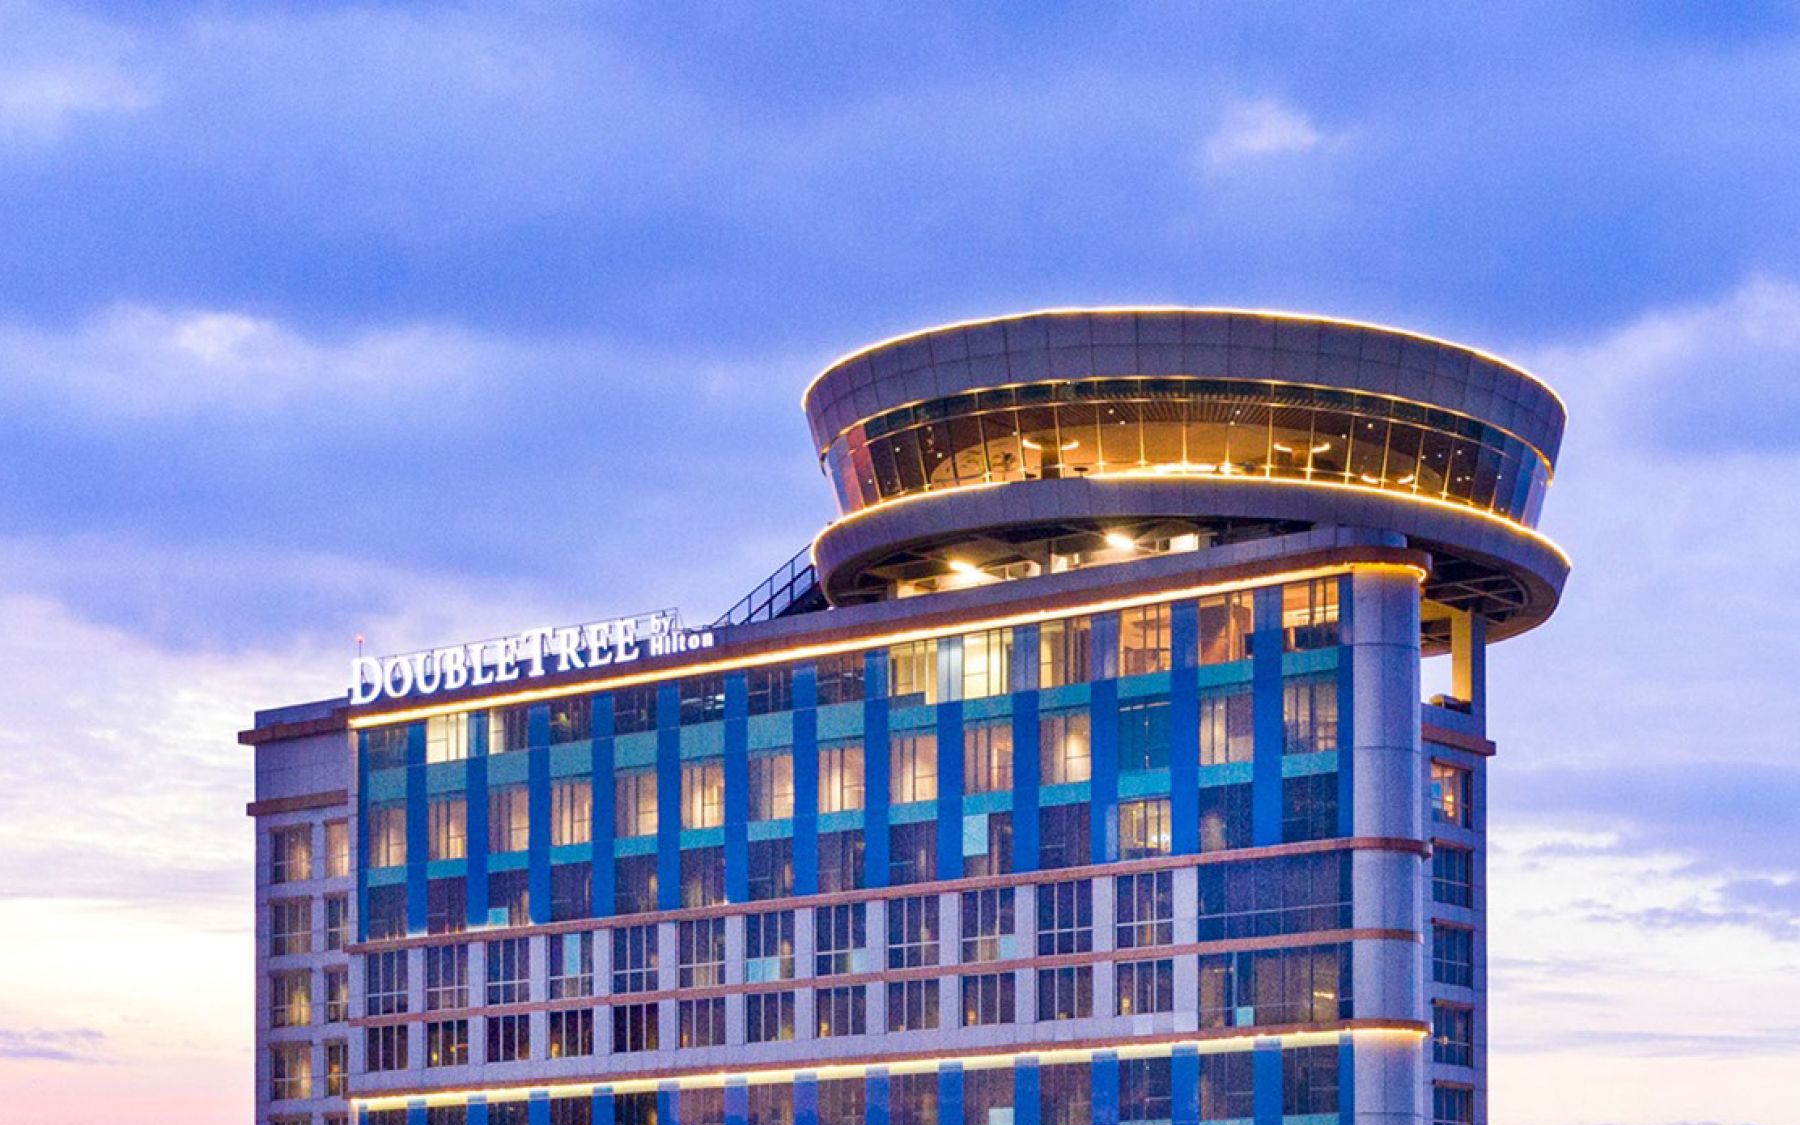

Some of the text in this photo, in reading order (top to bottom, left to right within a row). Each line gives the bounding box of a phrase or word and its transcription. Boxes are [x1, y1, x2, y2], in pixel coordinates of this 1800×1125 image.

[650, 614, 673, 635] by
[650, 632, 714, 657] Hilton
[350, 618, 639, 705] DOUBLETREE
